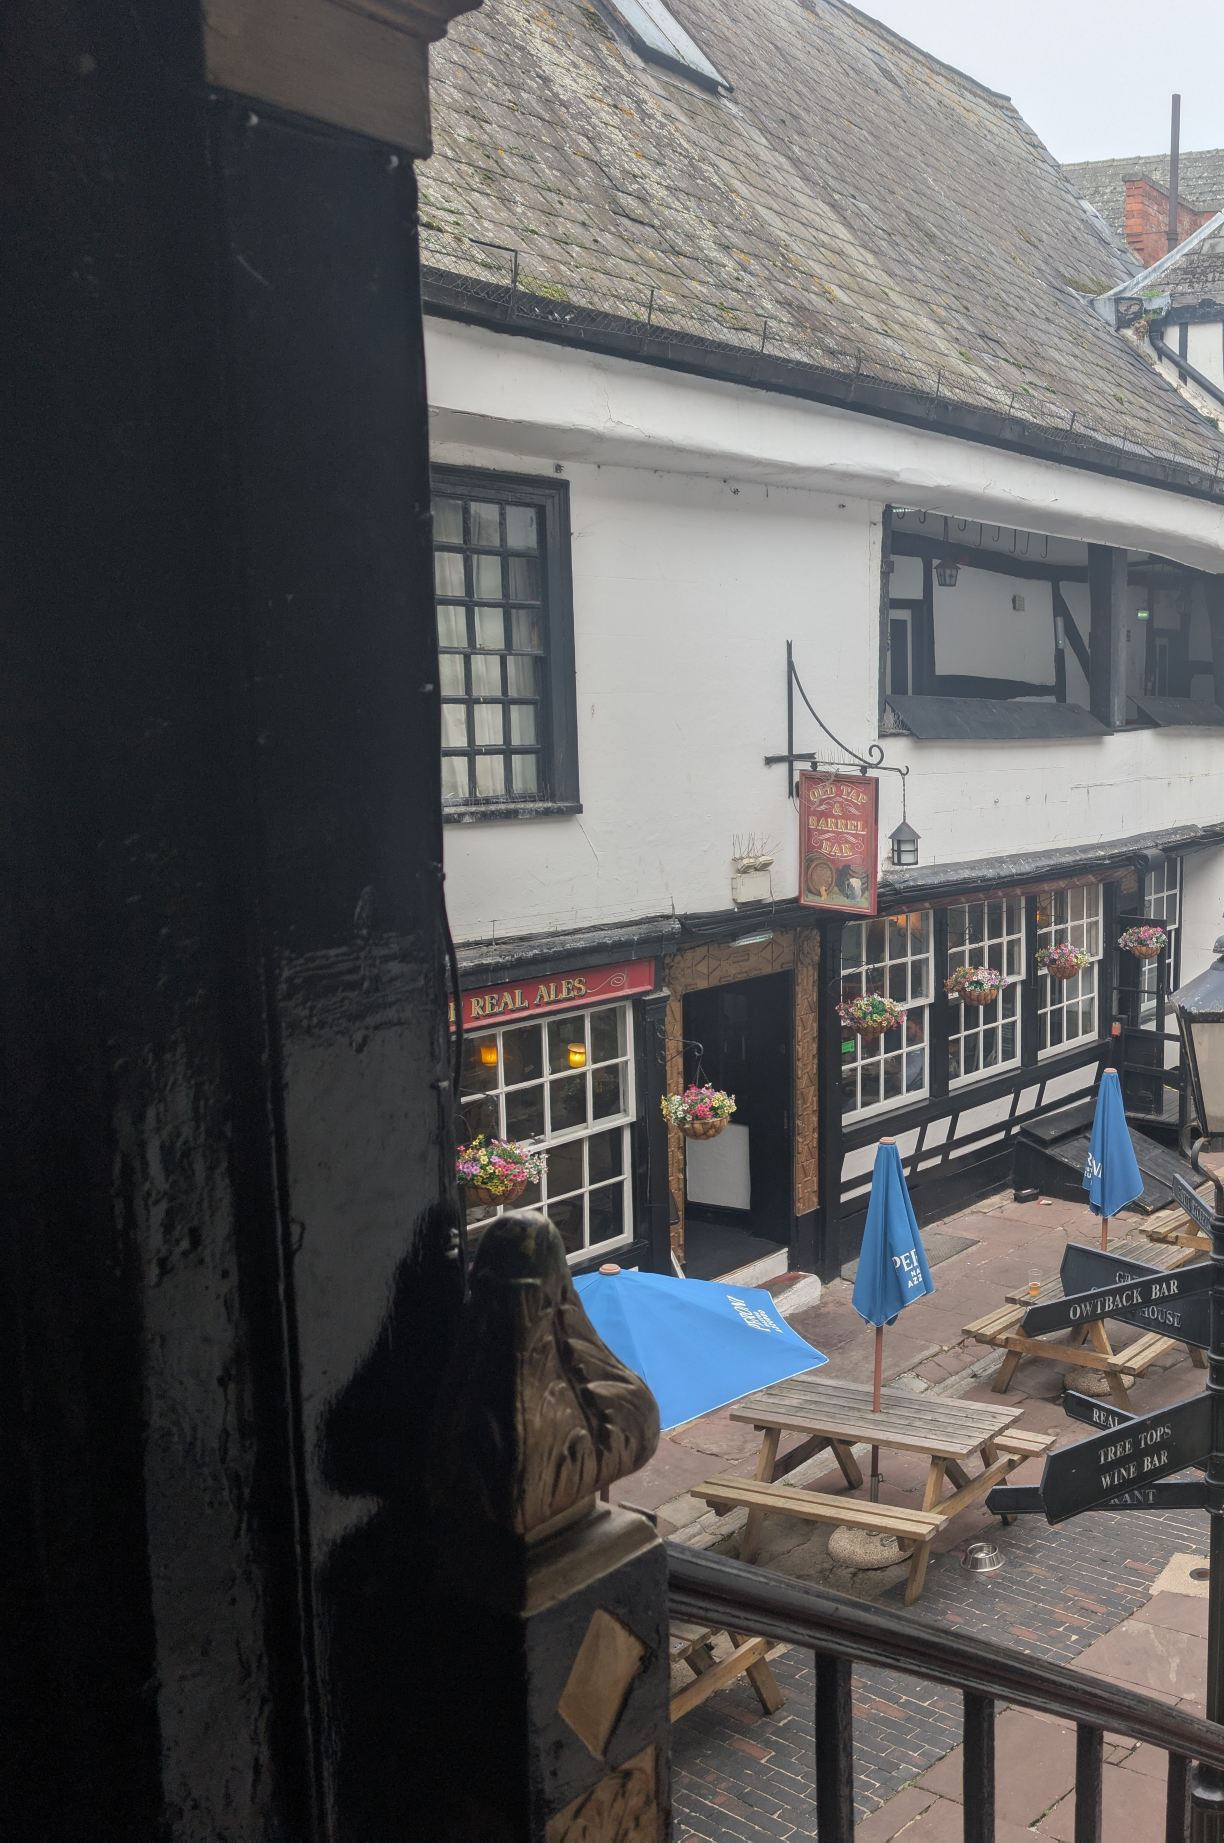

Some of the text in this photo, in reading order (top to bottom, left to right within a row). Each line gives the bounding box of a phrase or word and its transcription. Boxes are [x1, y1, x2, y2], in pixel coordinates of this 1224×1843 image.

[809, 785, 868, 804] OLD TAP
[832, 802, 842, 815] &
[808, 816, 867, 834] BARREL
[821, 840, 853, 856] BAR
[471, 990, 529, 1018] REAL
[534, 977, 587, 1005] ALES
[1069, 1279, 1179, 1320] OWTBACK BAR
[1098, 1423, 1172, 1465] TREE TOPS
[1101, 1450, 1169, 1490] WINE BAR
